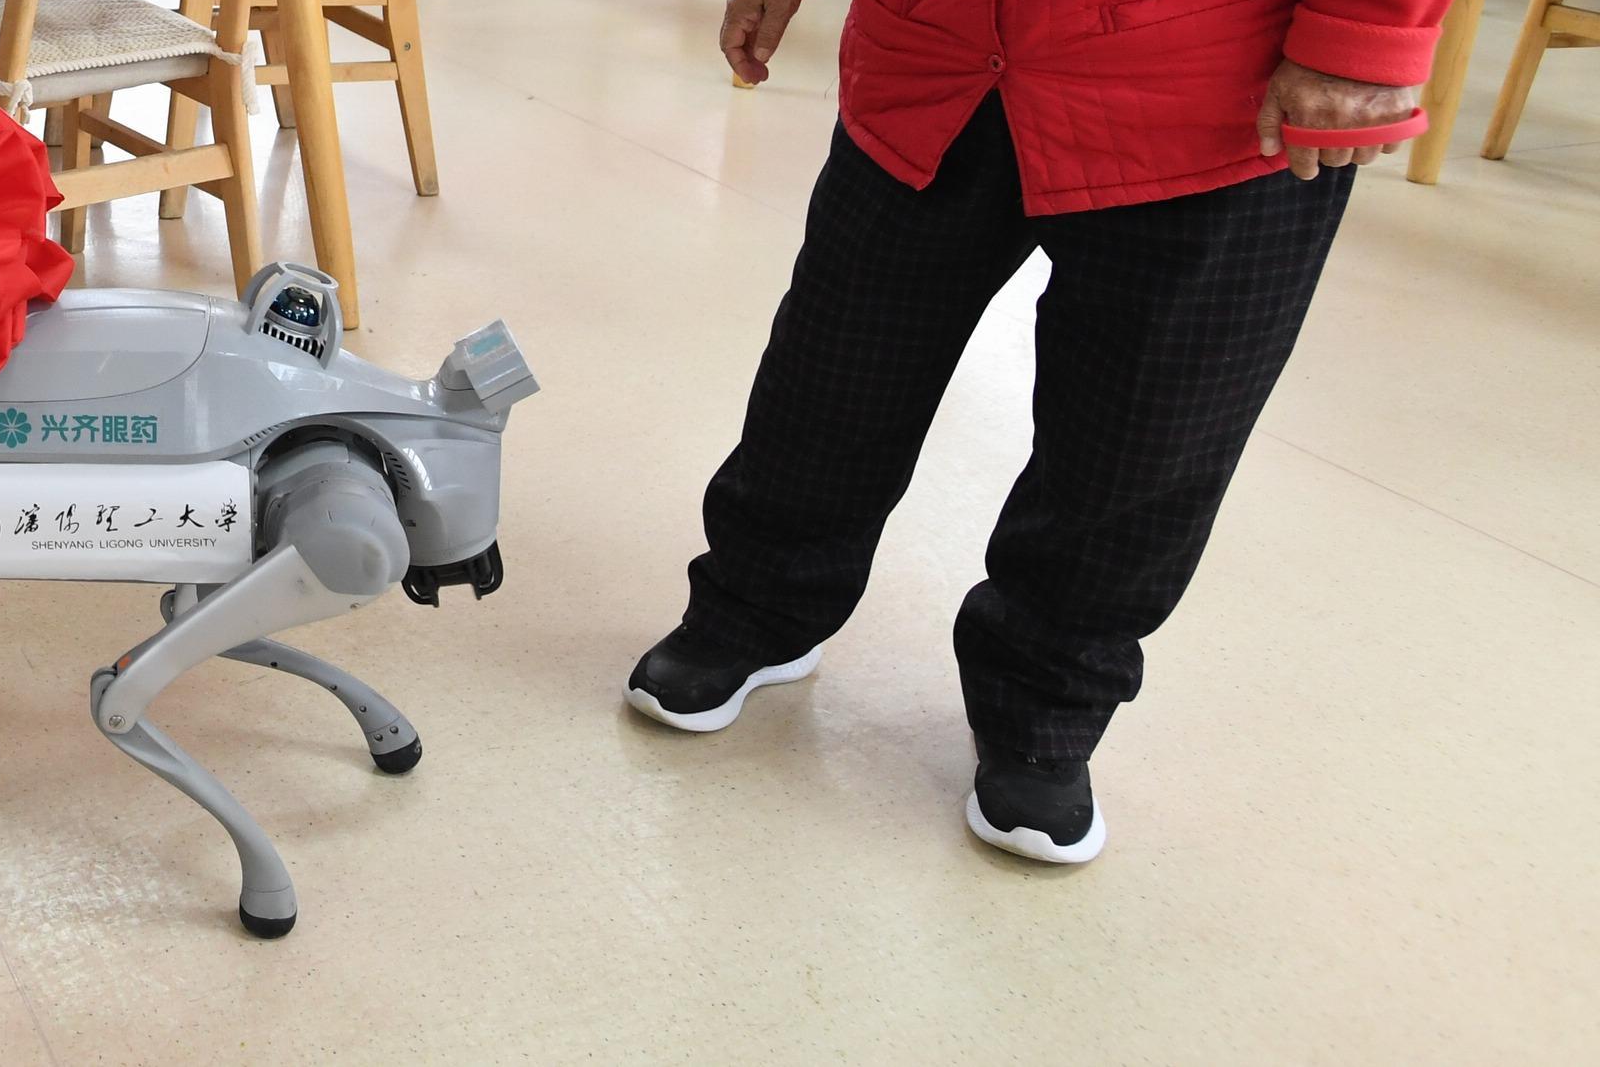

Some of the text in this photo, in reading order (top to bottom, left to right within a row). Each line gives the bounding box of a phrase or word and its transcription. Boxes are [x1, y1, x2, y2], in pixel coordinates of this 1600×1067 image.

[41, 414, 158, 444] 兴齐眼药
[31, 537, 218, 550] SHENYANG LIGONG UNIVERSITY
